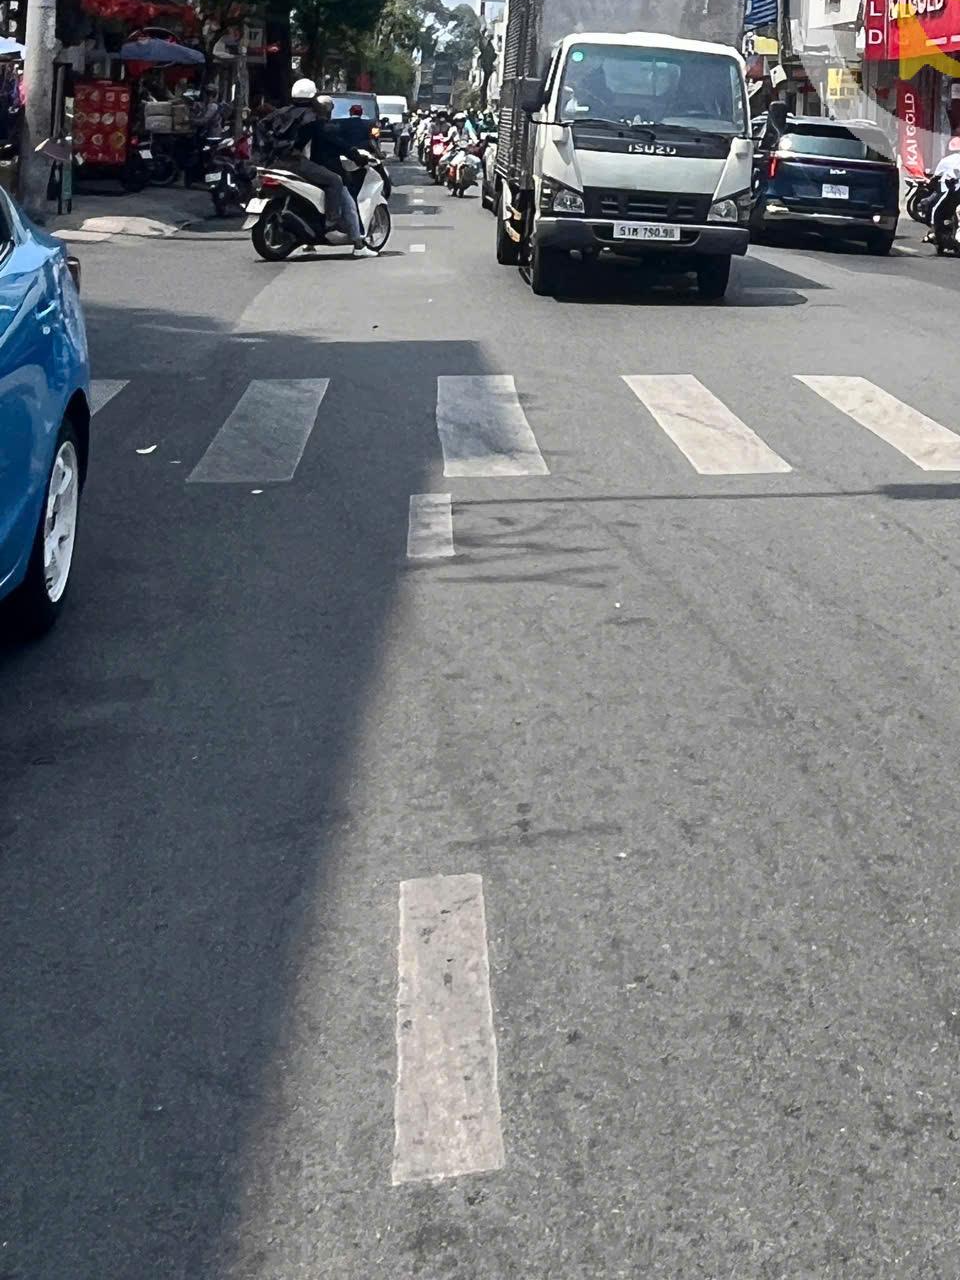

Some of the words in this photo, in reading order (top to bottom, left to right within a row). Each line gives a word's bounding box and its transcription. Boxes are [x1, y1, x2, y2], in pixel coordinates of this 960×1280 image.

[904, 93, 916, 136] GOLD
[628, 143, 677, 155] ISUZU
[905, 140, 918, 166] KAI
